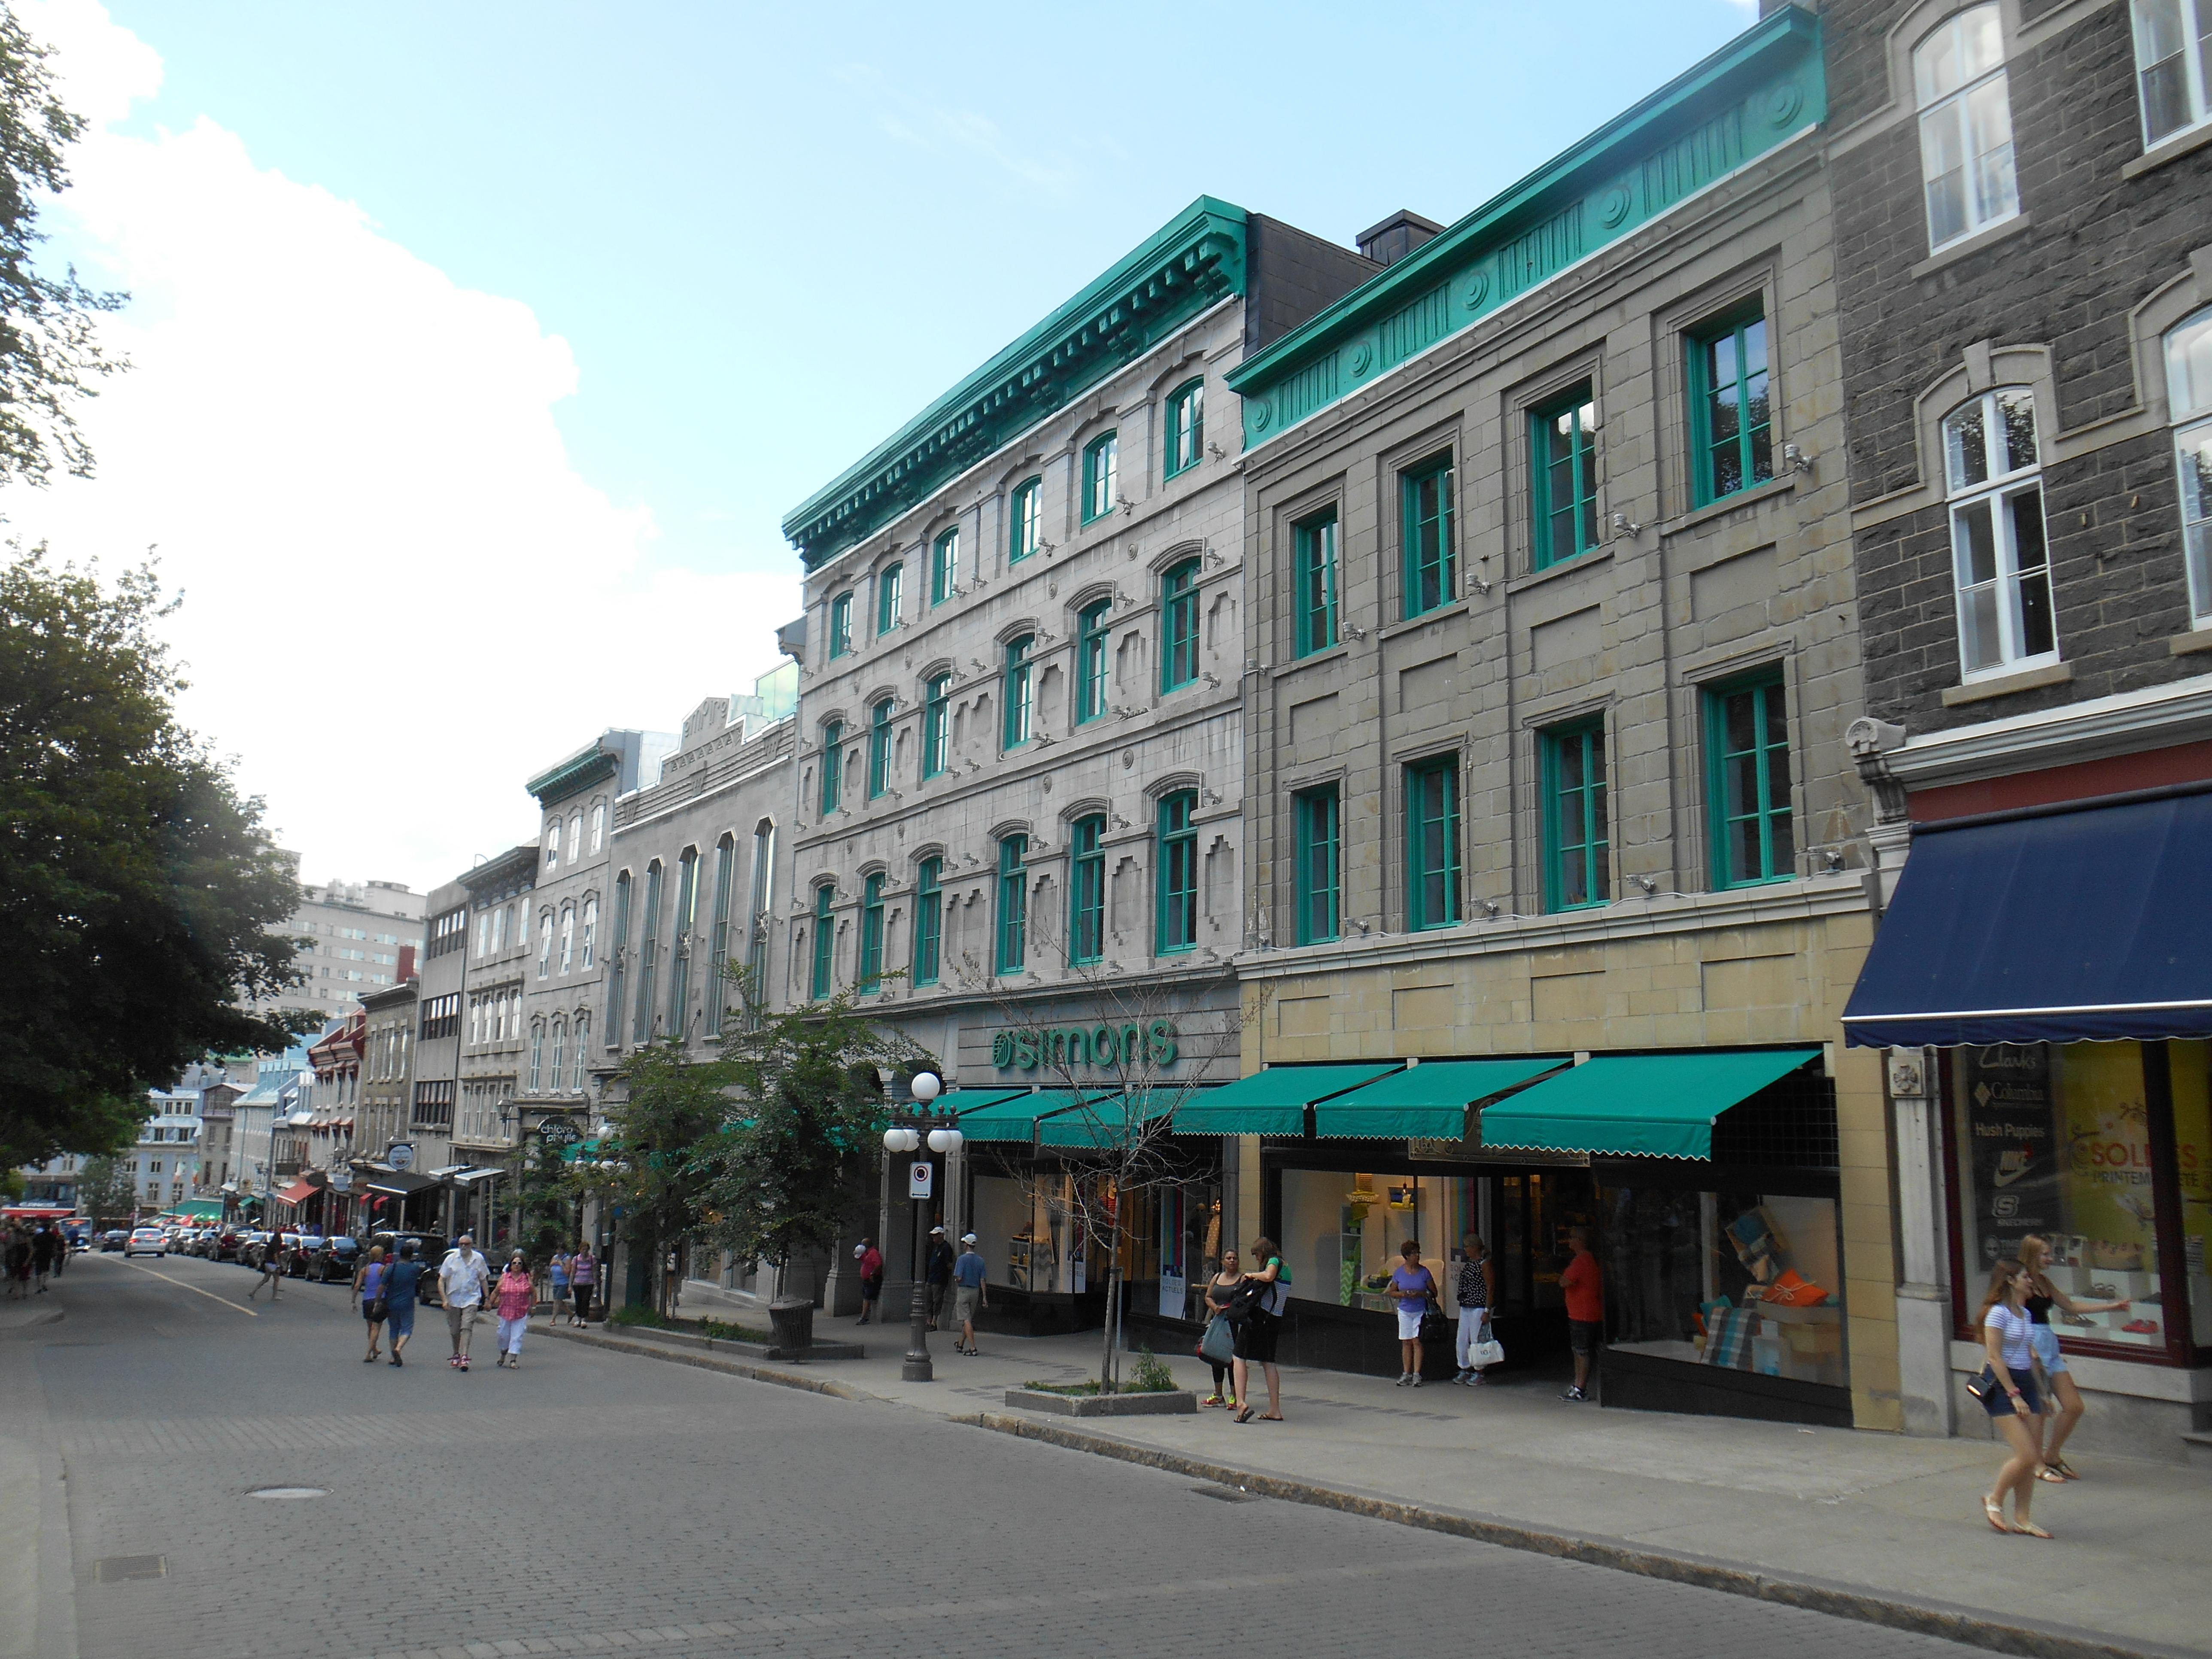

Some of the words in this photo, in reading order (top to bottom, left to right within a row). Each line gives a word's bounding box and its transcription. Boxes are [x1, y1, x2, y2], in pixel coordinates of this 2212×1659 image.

[1015, 1019, 1178, 1069] simons
[1991, 1082, 2044, 1100] Columbia
[1975, 1122, 2003, 1136] Hush
[2005, 1123, 2045, 1140] Puppies
[2000, 1151, 2027, 1171] NIKE
[2091, 1142, 2199, 1168] SOLS
[2092, 1170, 2152, 1186] PRINTEM
[1162, 1286, 1183, 1294] ACTUELS
